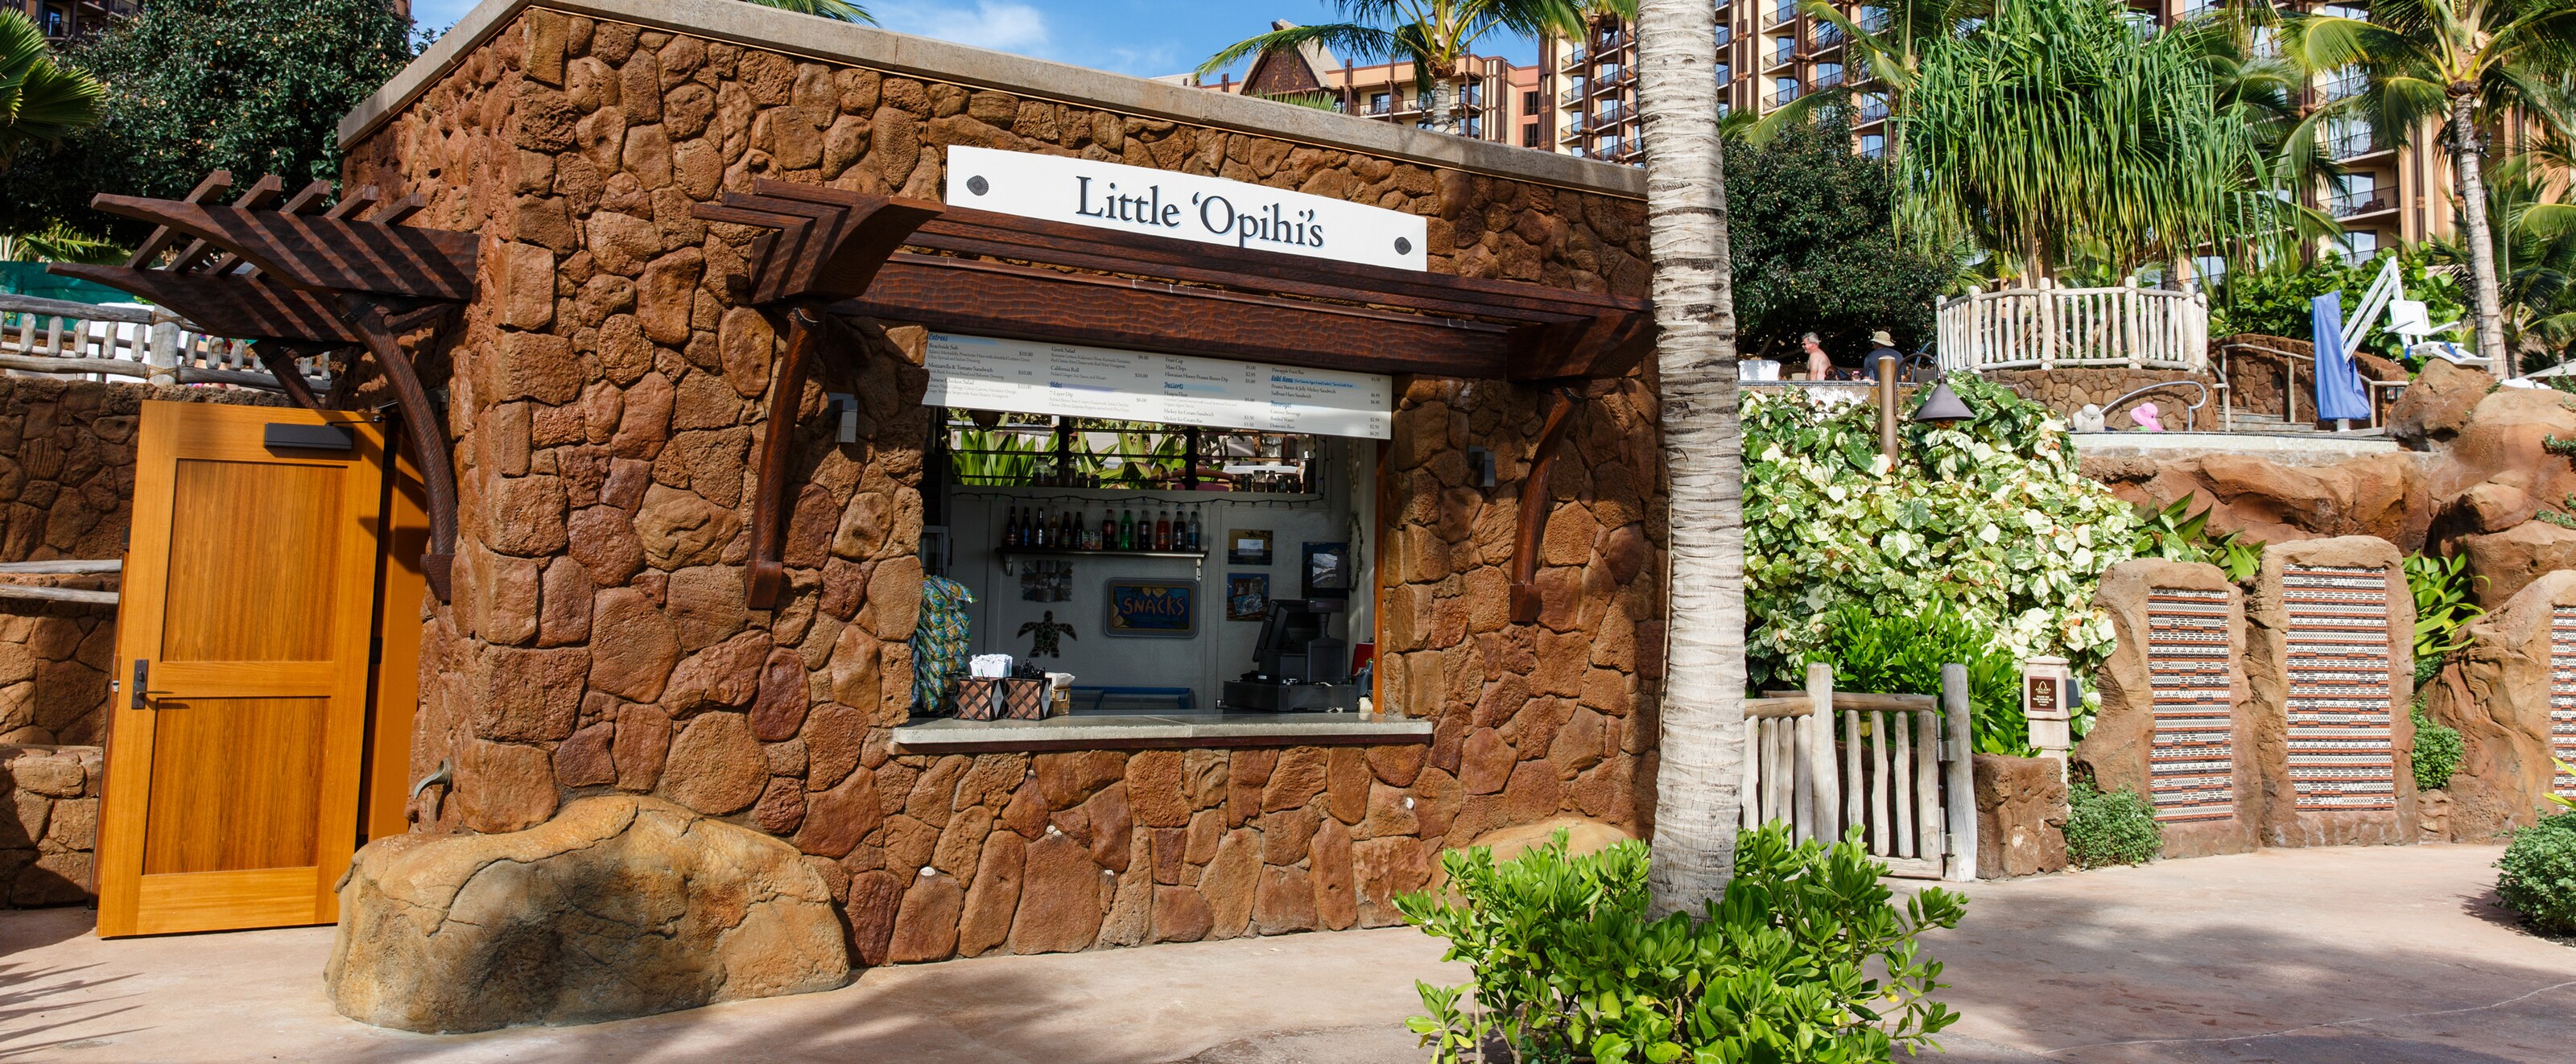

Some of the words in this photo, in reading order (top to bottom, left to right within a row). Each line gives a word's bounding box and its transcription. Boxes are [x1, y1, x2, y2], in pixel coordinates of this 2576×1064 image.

[1075, 175, 1181, 228] Little
[929, 333, 948, 341] Entrees
[1050, 381, 1063, 389] Sides
[1164, 381, 1183, 390] Desserts
[1123, 596, 1184, 616] SNACKS
